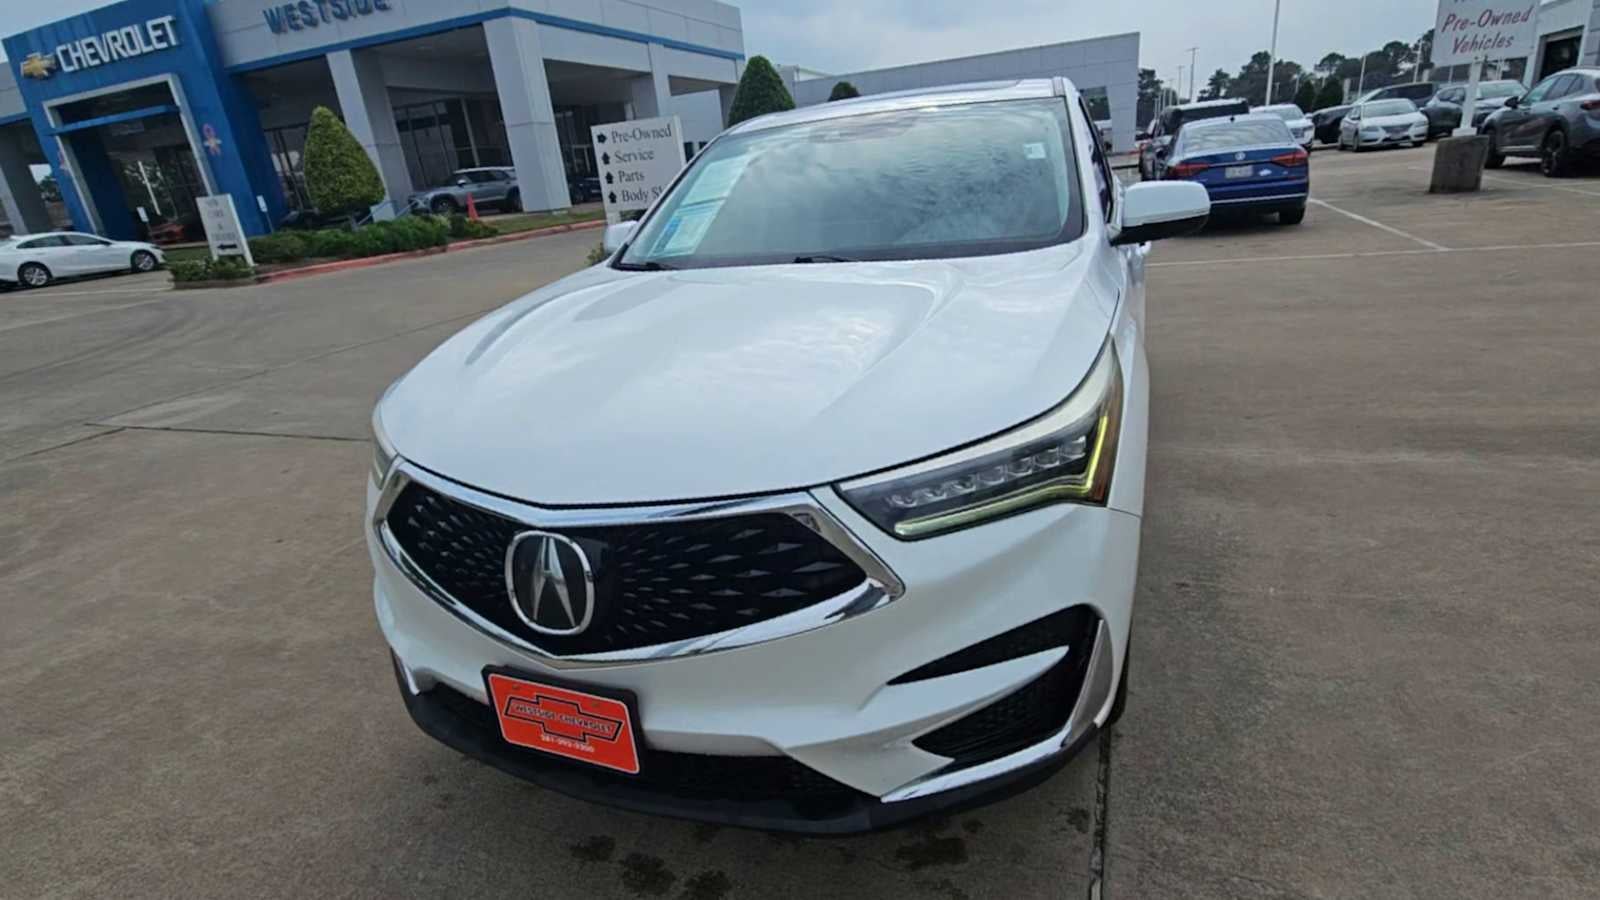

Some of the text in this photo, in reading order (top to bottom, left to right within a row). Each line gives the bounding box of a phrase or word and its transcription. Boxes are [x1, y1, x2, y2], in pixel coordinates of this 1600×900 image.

[1441, 6, 1534, 32] Pre-Owned
[56, 15, 178, 72] CHEVROLET
[1453, 32, 1514, 54] Vehicles
[611, 124, 672, 143] Pre-Owned
[614, 151, 655, 164] Service
[618, 171, 644, 182] Parts
[622, 188, 648, 203] Body
